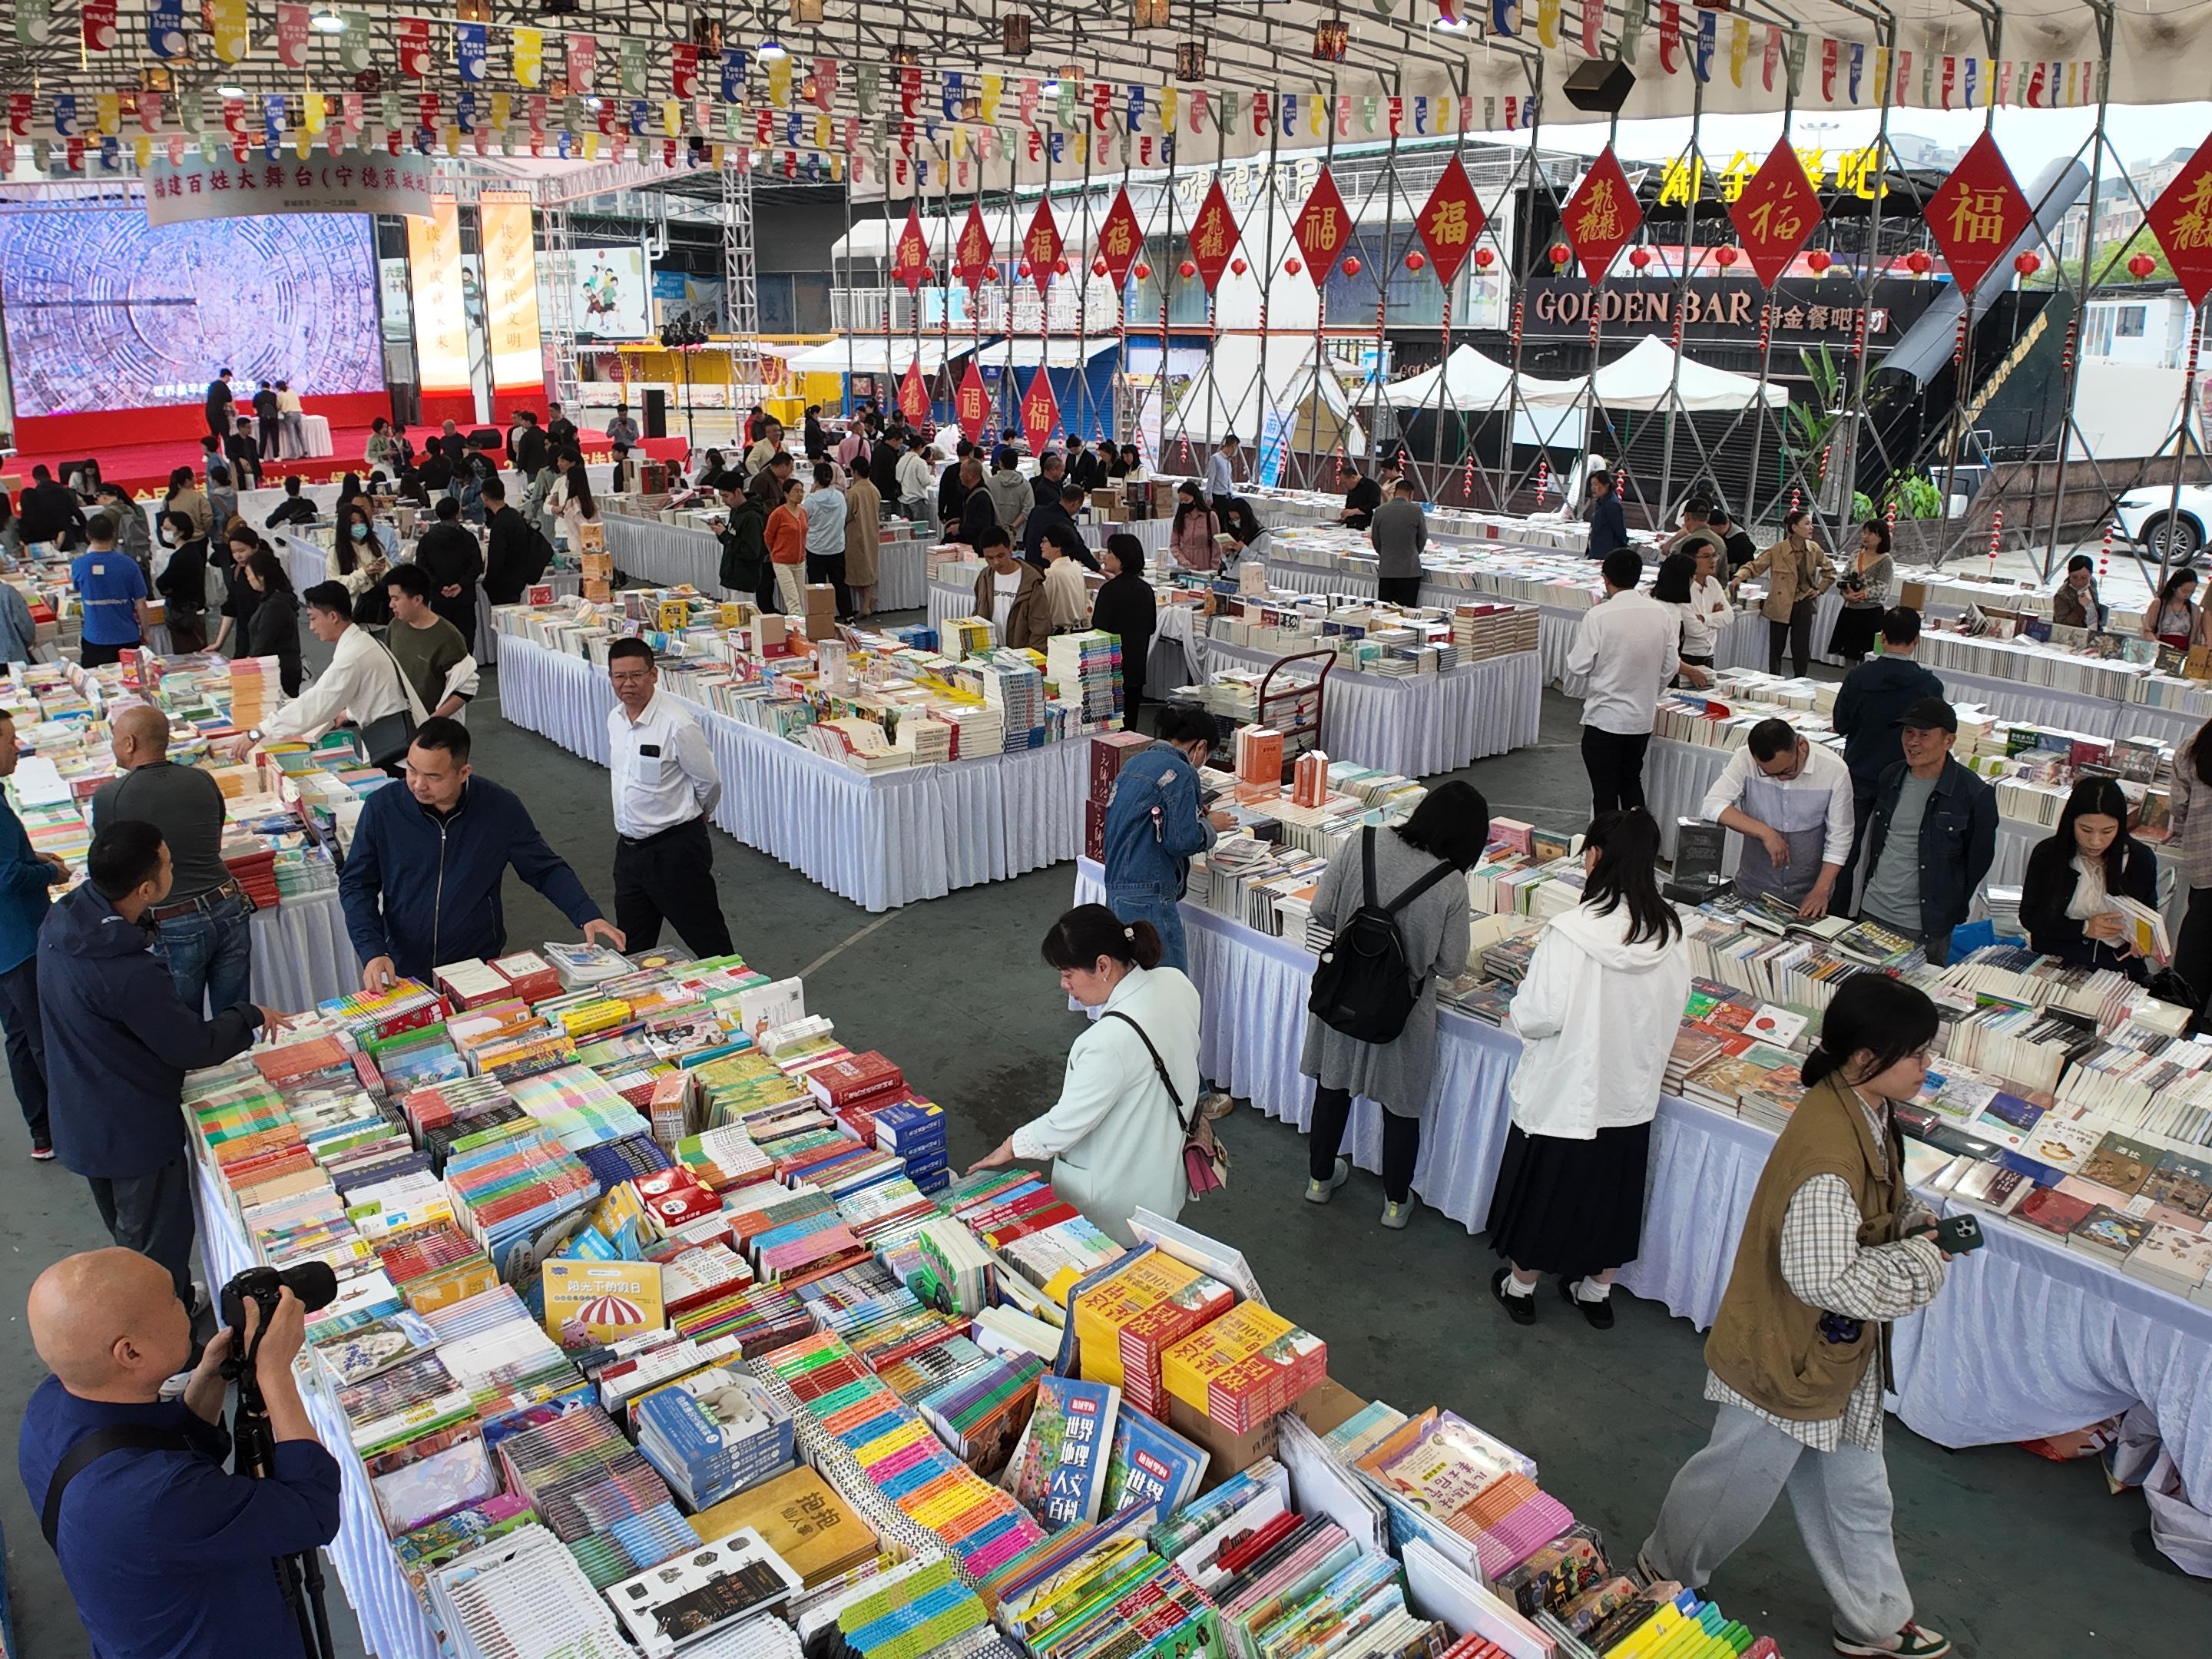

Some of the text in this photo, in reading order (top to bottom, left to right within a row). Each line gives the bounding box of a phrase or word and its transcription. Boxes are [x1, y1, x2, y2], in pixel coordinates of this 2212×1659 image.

[1305, 205, 1337, 251] 福
[1429, 200, 1469, 245] 福
[1747, 181, 1802, 245] 福
[1946, 182, 2008, 245] 福
[902, 236, 922, 267] 福
[1030, 228, 1053, 263] 福
[1107, 217, 1131, 257] 福
[1536, 288, 1756, 326] GOLDEN BAR
[962, 387, 981, 420] 福
[1028, 394, 1051, 432] 福
[1065, 1416, 1094, 1443] 世界
[1060, 1441, 1090, 1469] 地理
[1053, 1469, 1084, 1498] 人文
[1125, 1467, 1165, 1503] 世界
[1048, 1496, 1078, 1524] 百科
